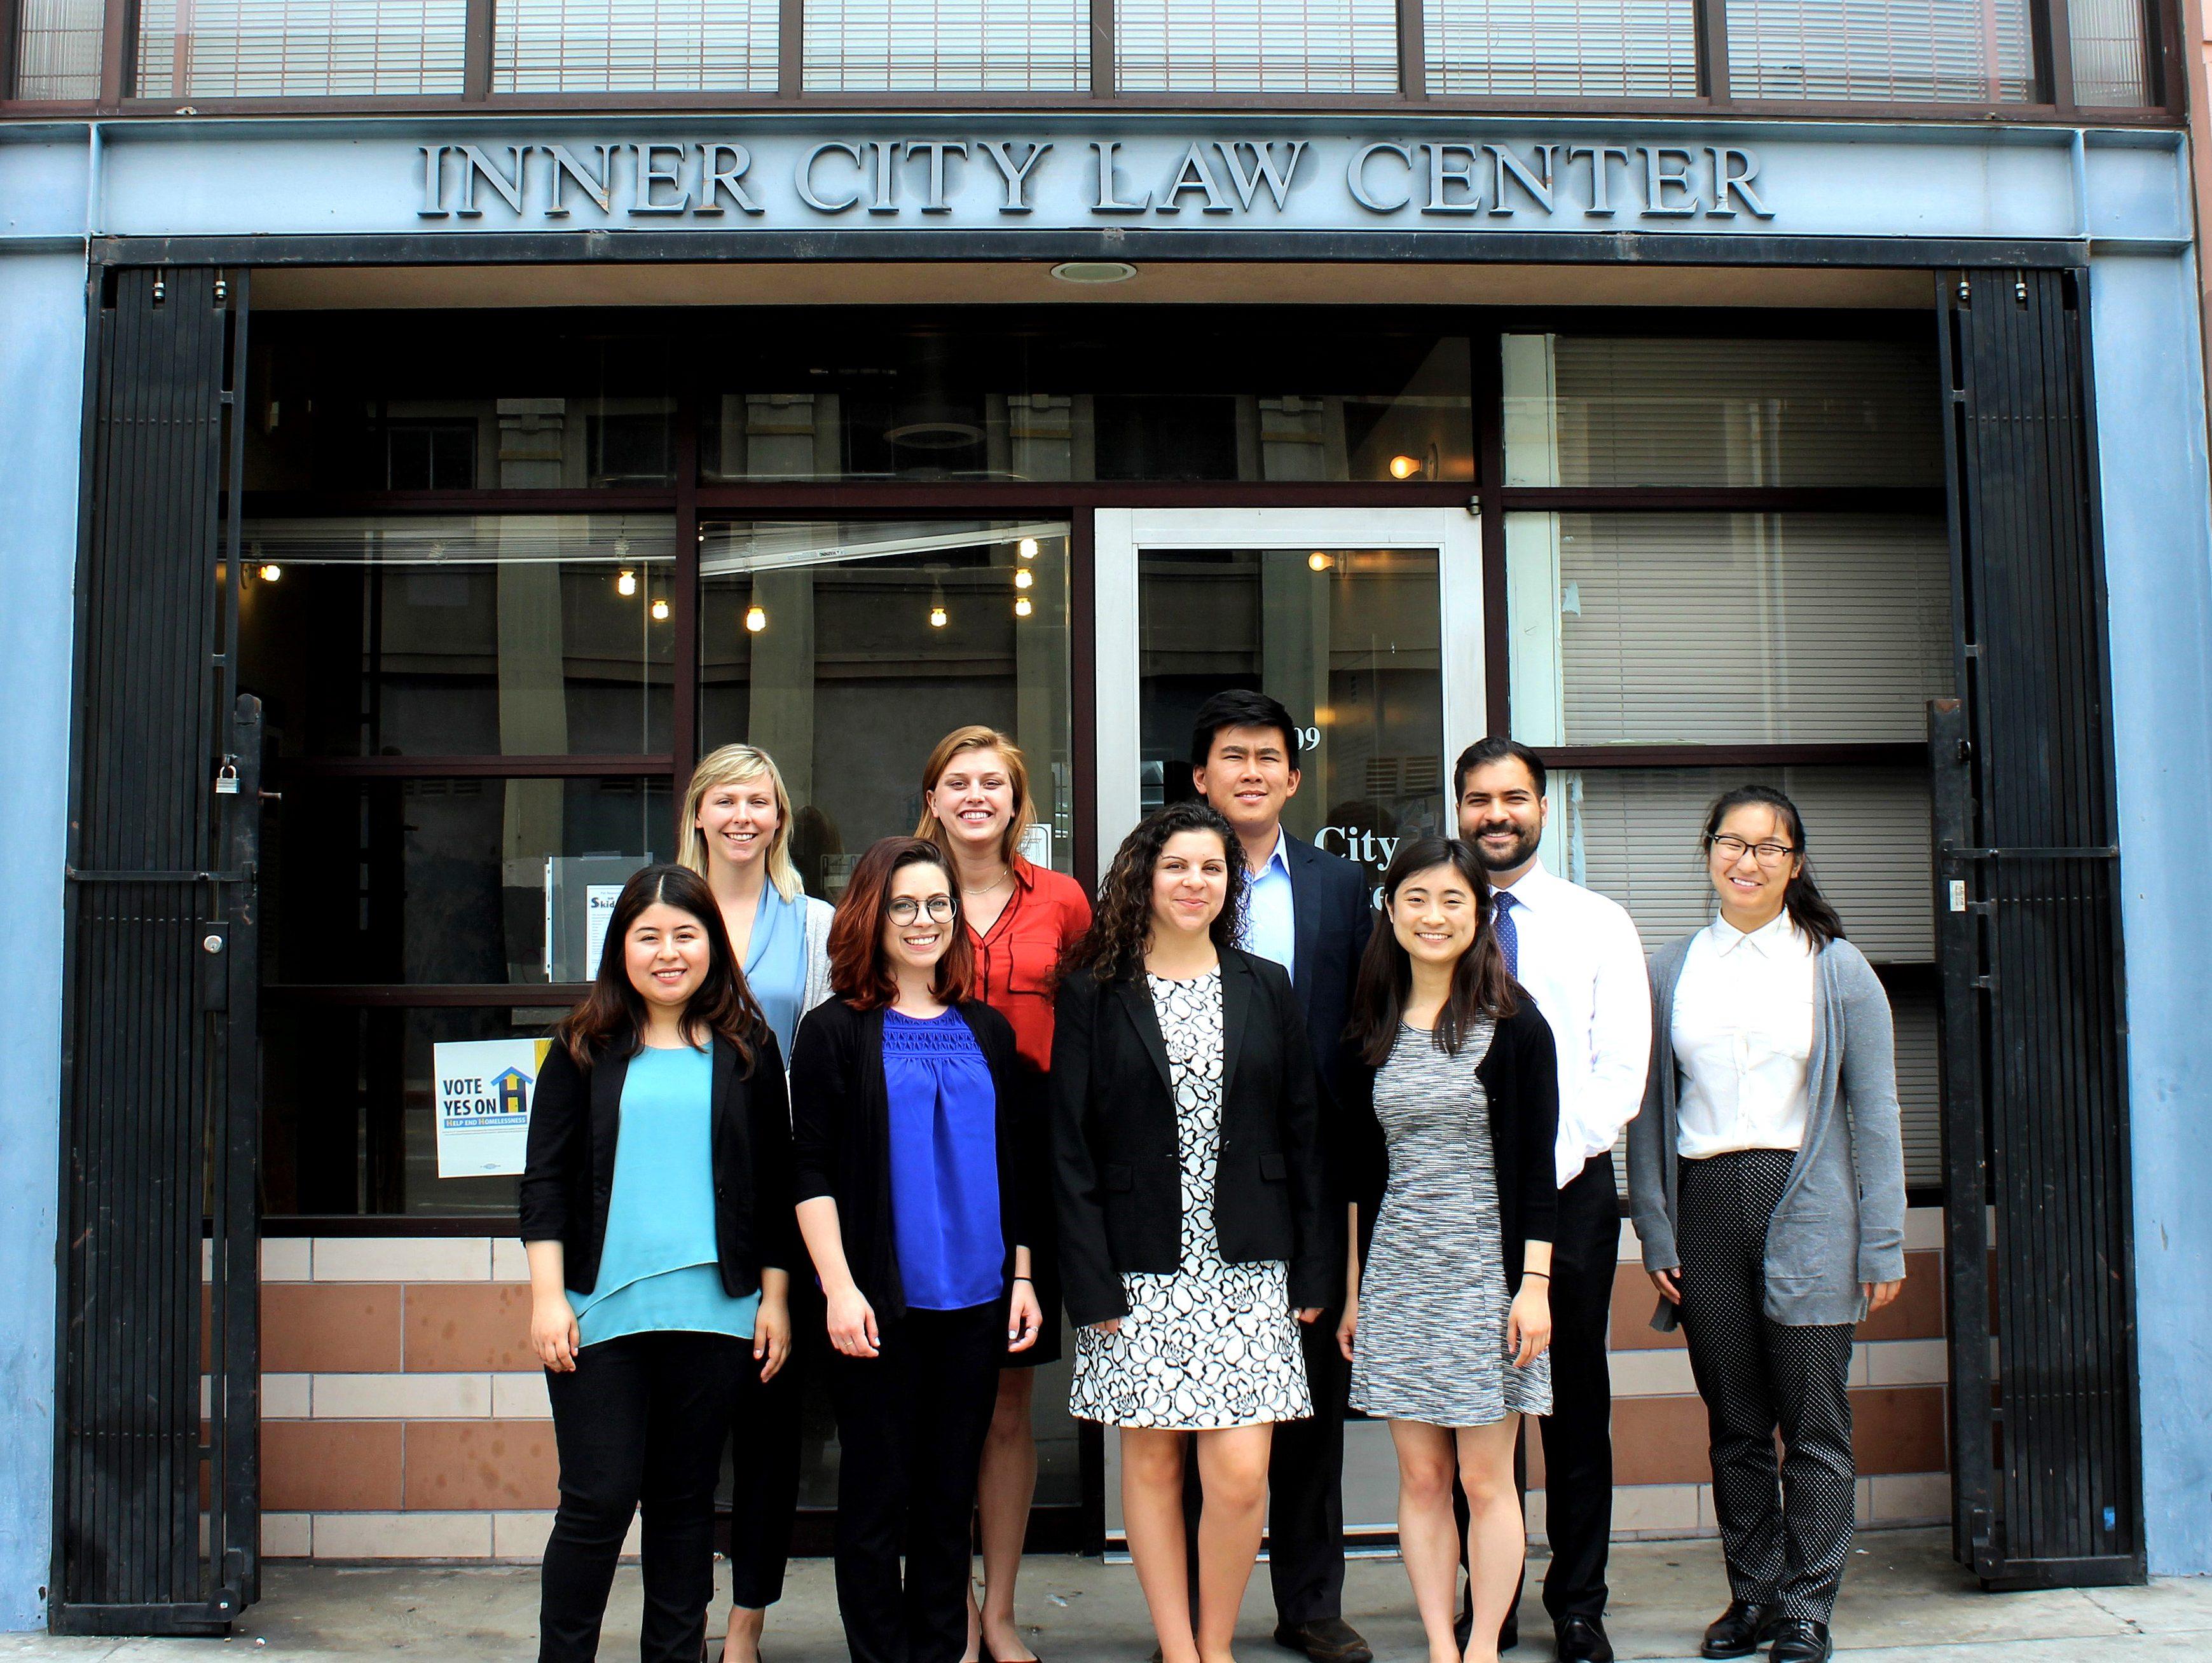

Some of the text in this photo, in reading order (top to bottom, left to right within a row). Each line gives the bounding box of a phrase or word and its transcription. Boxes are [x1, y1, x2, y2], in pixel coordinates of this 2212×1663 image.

[417, 140, 1776, 219] INNER CITY LAW CENTER
[1314, 826, 1400, 871] City
[591, 897, 615, 908] Skid
[443, 1078, 483, 1095] VOTE
[444, 1100, 471, 1116] YES
[474, 1098, 497, 1114] ON
